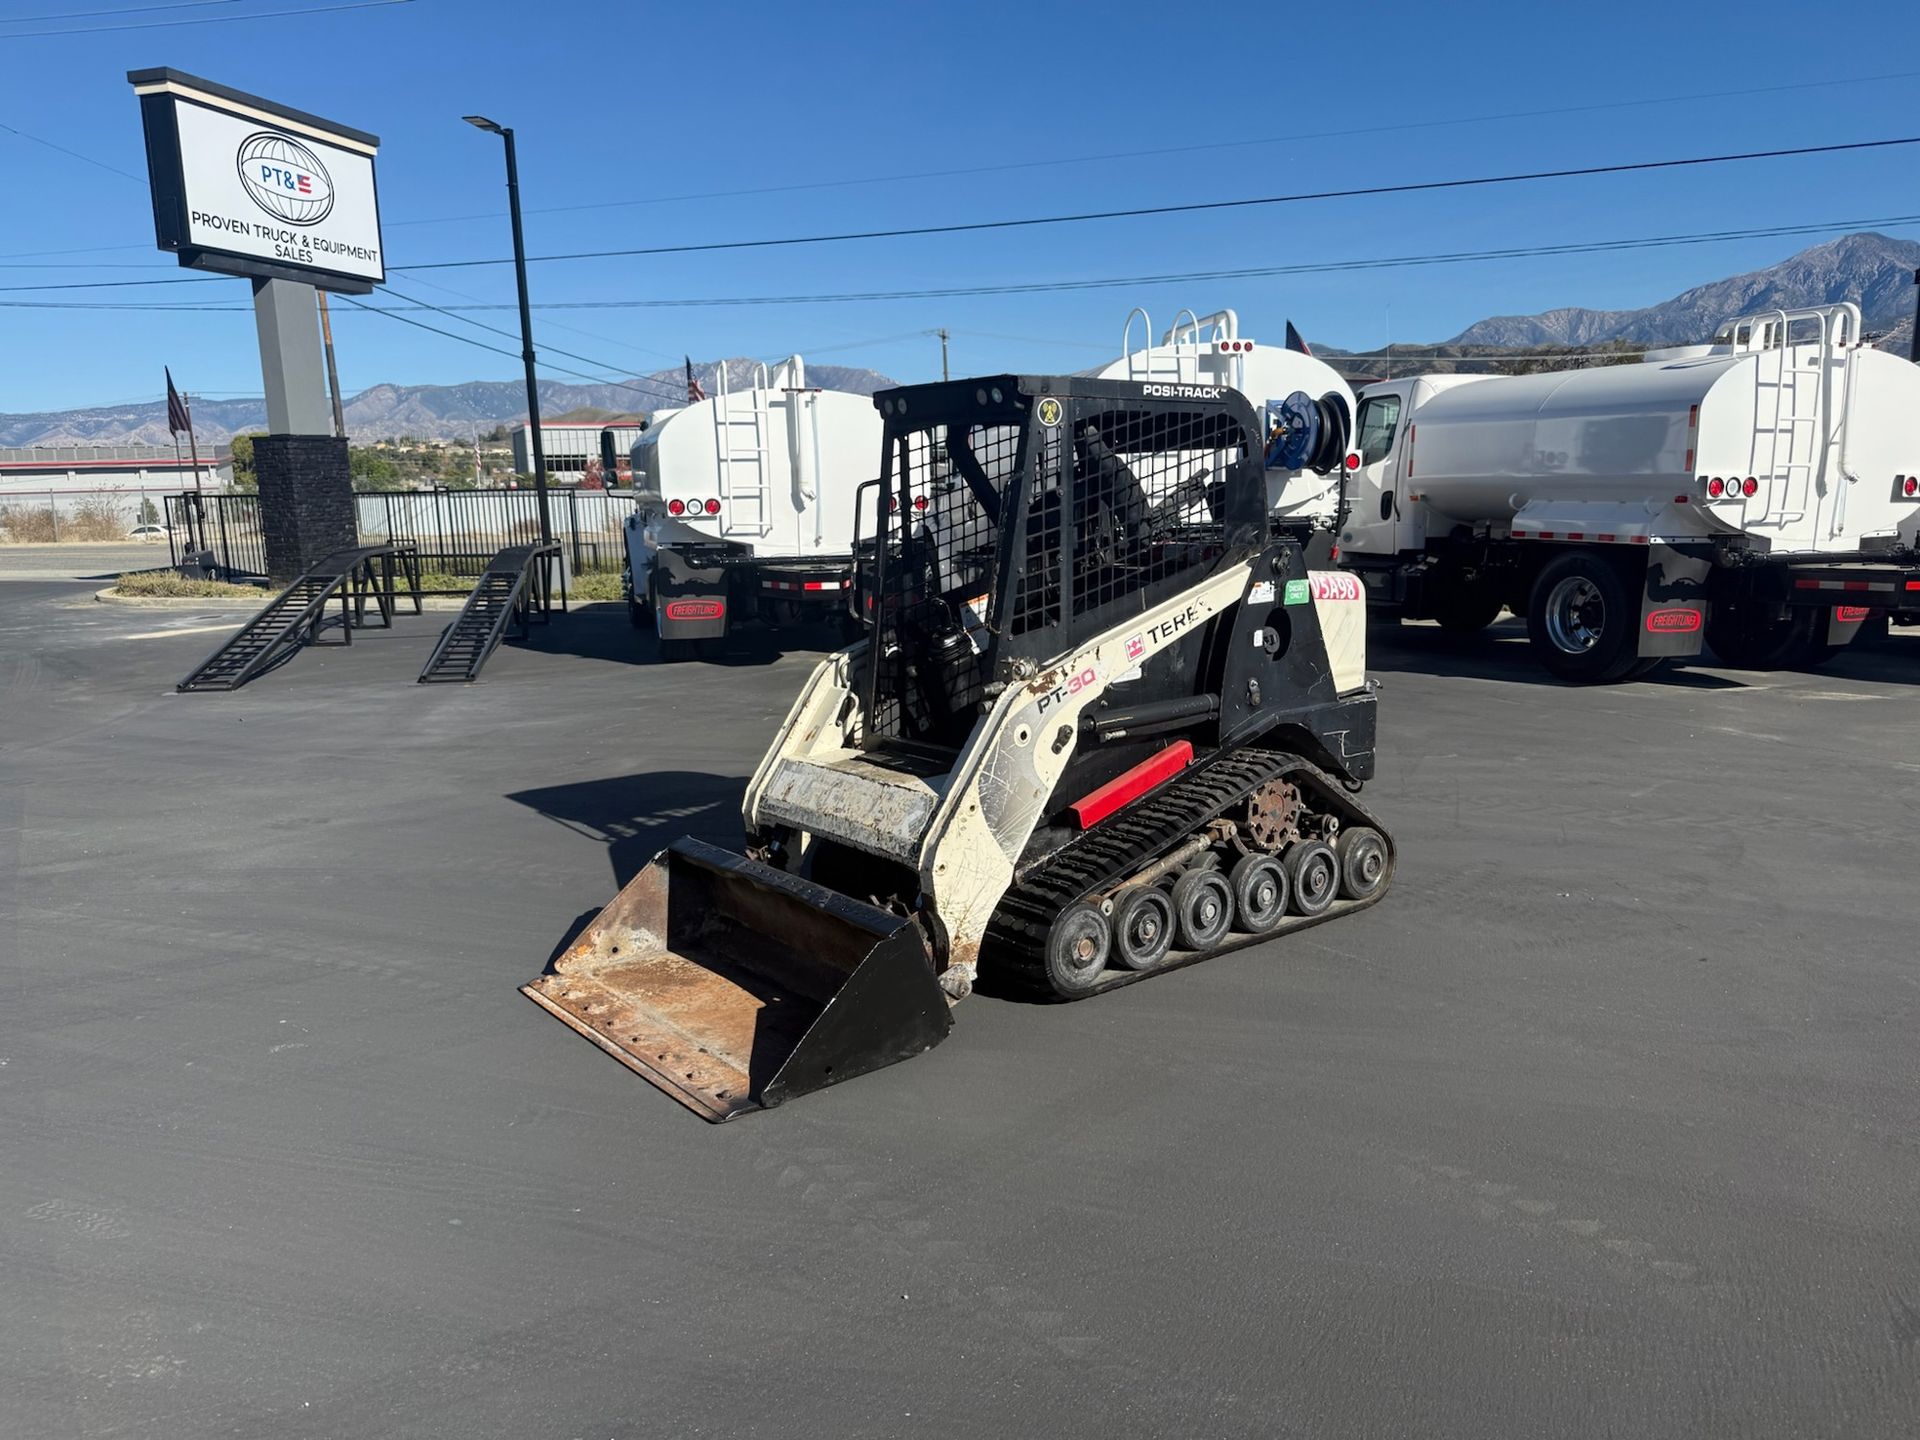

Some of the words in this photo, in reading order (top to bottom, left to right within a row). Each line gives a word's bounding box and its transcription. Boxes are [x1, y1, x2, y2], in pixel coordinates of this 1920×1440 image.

[261, 165, 312, 194] PT&E
[192, 211, 250, 235] PROVEN
[253, 224, 297, 246] TRUCK
[301, 235, 310, 248] &
[314, 238, 378, 262] EQUIPMENT
[275, 244, 313, 263] SALES
[1147, 593, 1212, 644] TERE
